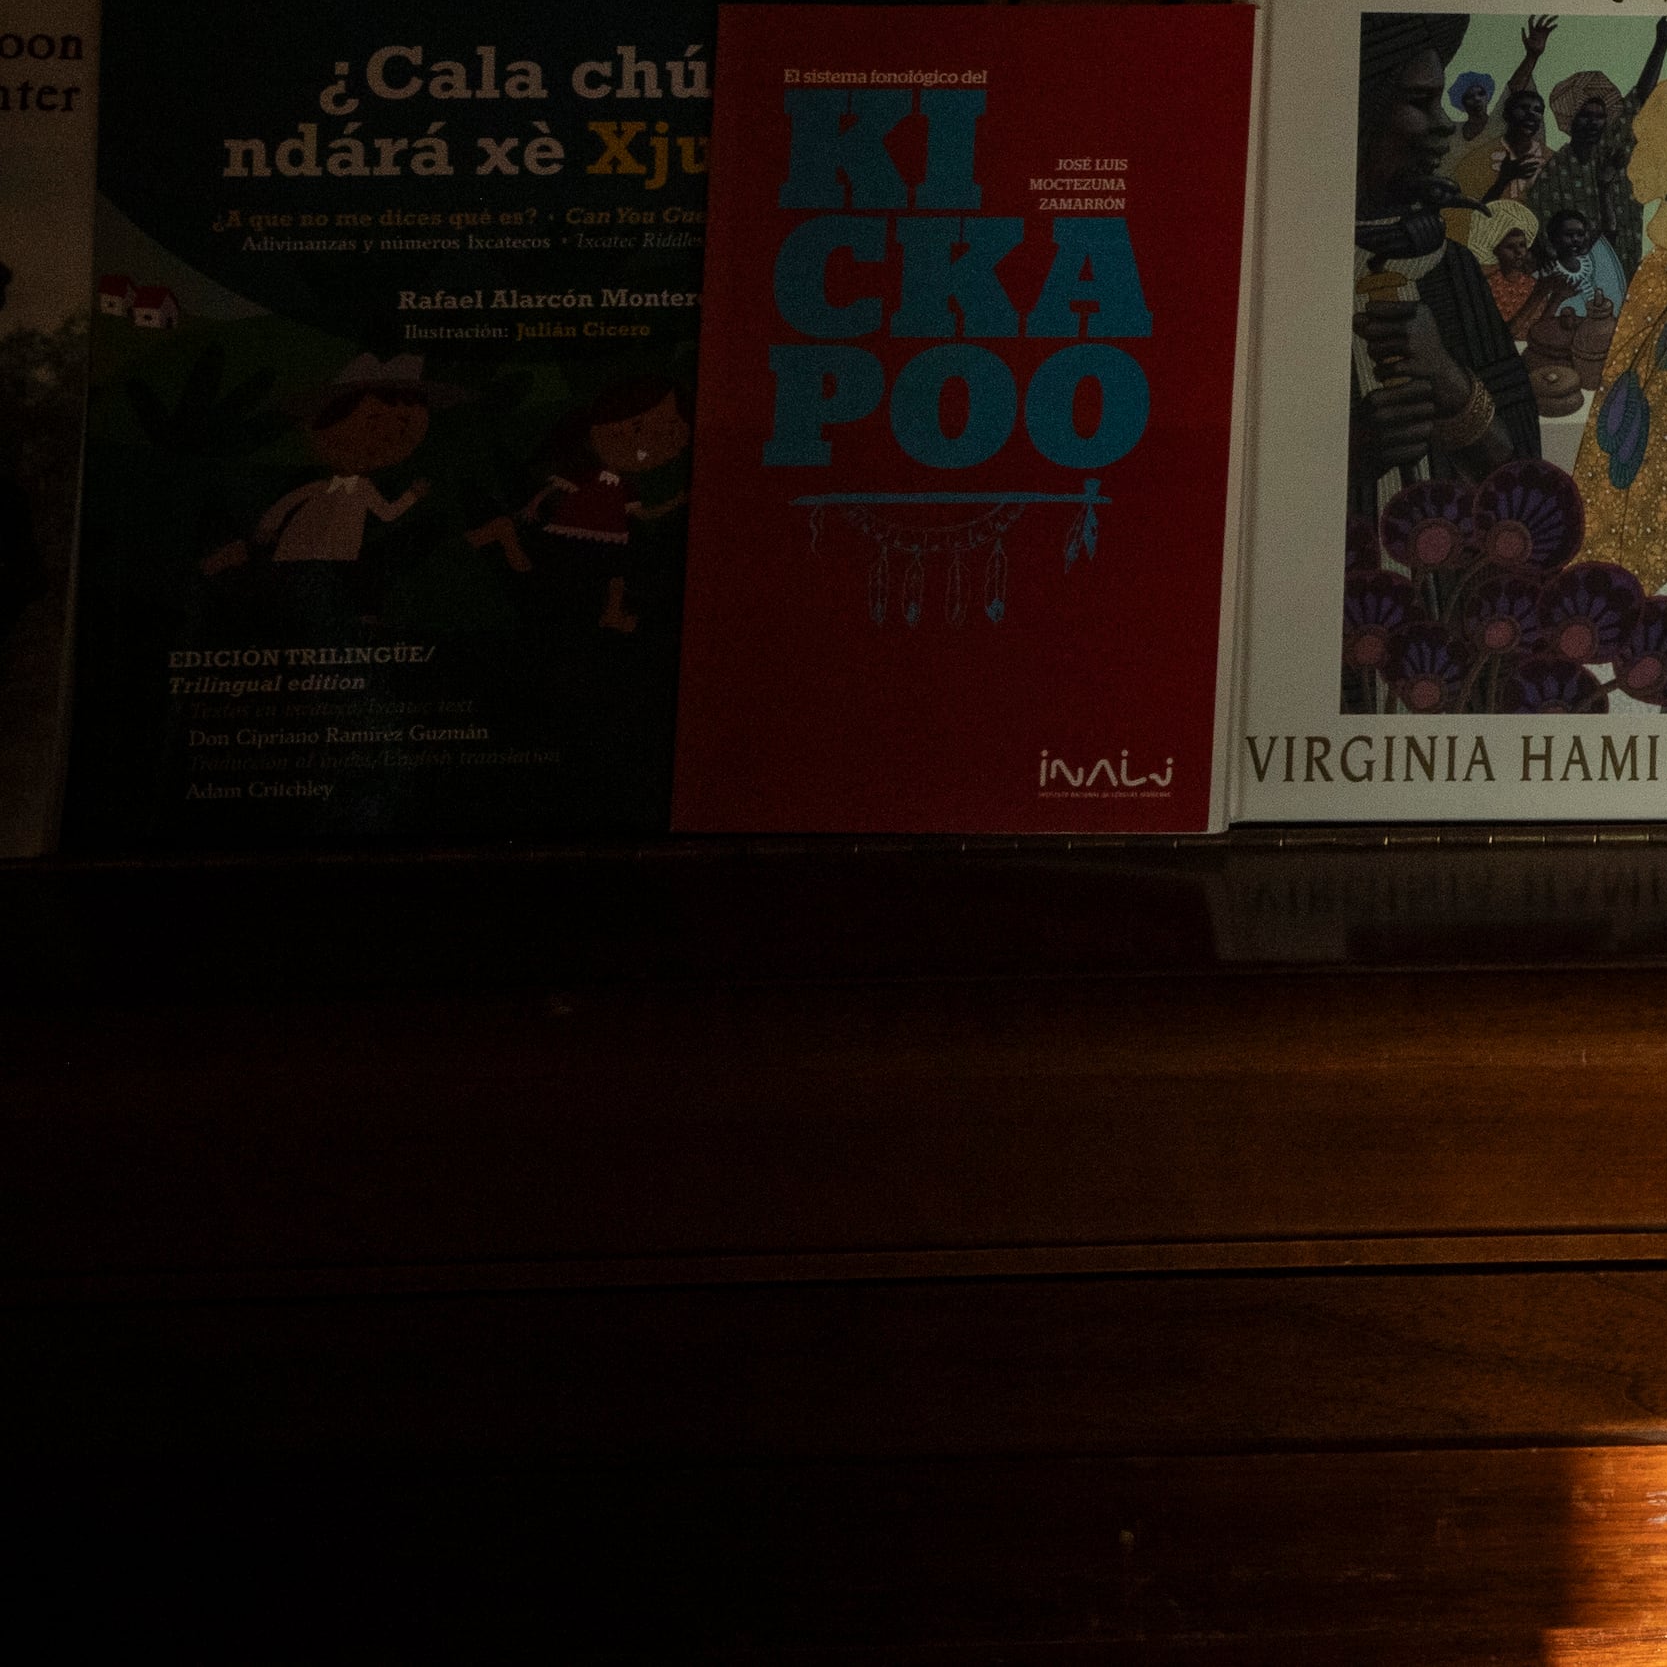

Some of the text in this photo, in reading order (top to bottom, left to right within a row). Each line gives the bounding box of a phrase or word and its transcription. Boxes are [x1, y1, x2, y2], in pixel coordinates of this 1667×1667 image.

[319, 44, 549, 116] ¿Cala
[784, 69, 988, 87] El sistema fonológico del
[778, 88, 987, 209] KI
[1055, 157, 1128, 171] JOSÉ LUIS
[1029, 178, 1126, 191] MOCTEZUMA
[1040, 196, 1125, 211] ZAMARRÓN
[773, 214, 1154, 338] CKA
[398, 290, 485, 311] Rafael
[491, 288, 595, 309] Alarcón
[516, 321, 577, 341] Julián
[583, 321, 652, 338] Cicero
[762, 343, 1151, 469] POO
[168, 646, 280, 670] EDICIÓN
[168, 674, 367, 696] Trilingual edition
[188, 730, 230, 747] Don
[1244, 736, 1497, 785] VIRGINIA
[185, 781, 243, 800] Adam
